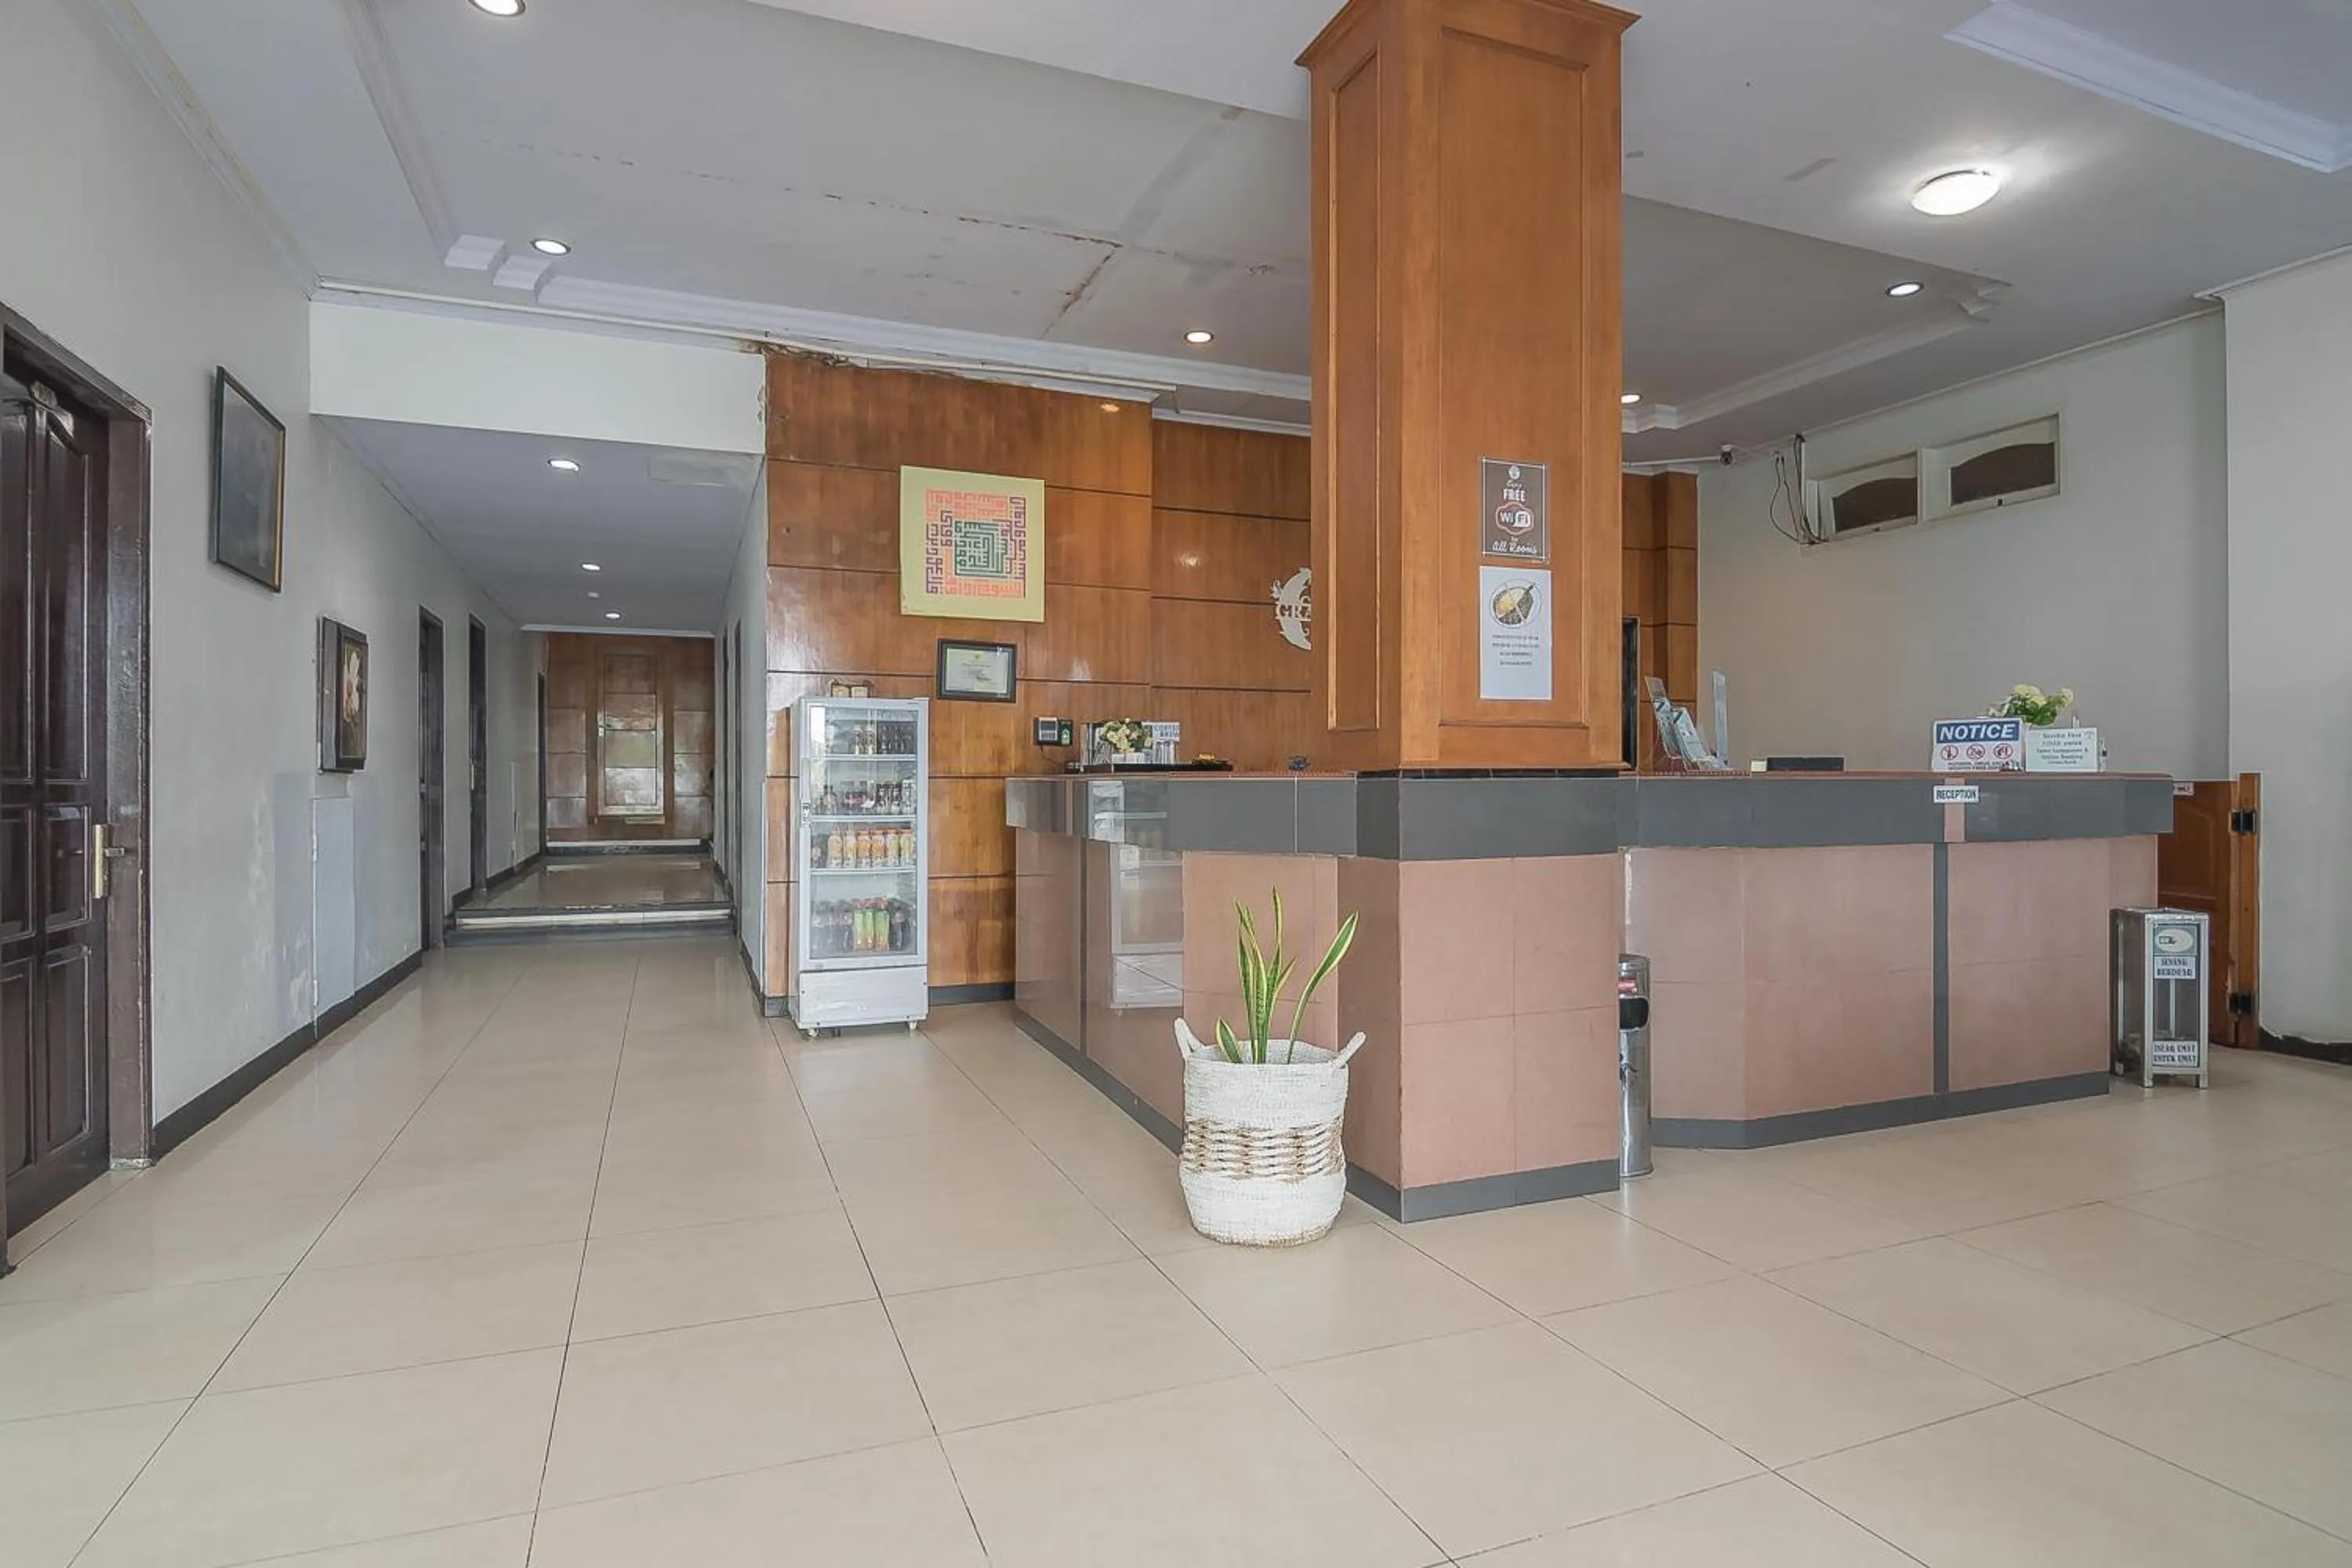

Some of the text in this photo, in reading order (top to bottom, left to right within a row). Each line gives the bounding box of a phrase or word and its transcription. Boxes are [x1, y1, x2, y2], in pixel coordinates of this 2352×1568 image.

[1503, 488, 1526, 502] FREE
[1940, 724, 2016, 741] NOTICE
[1936, 789, 1976, 800] RECEPTION
